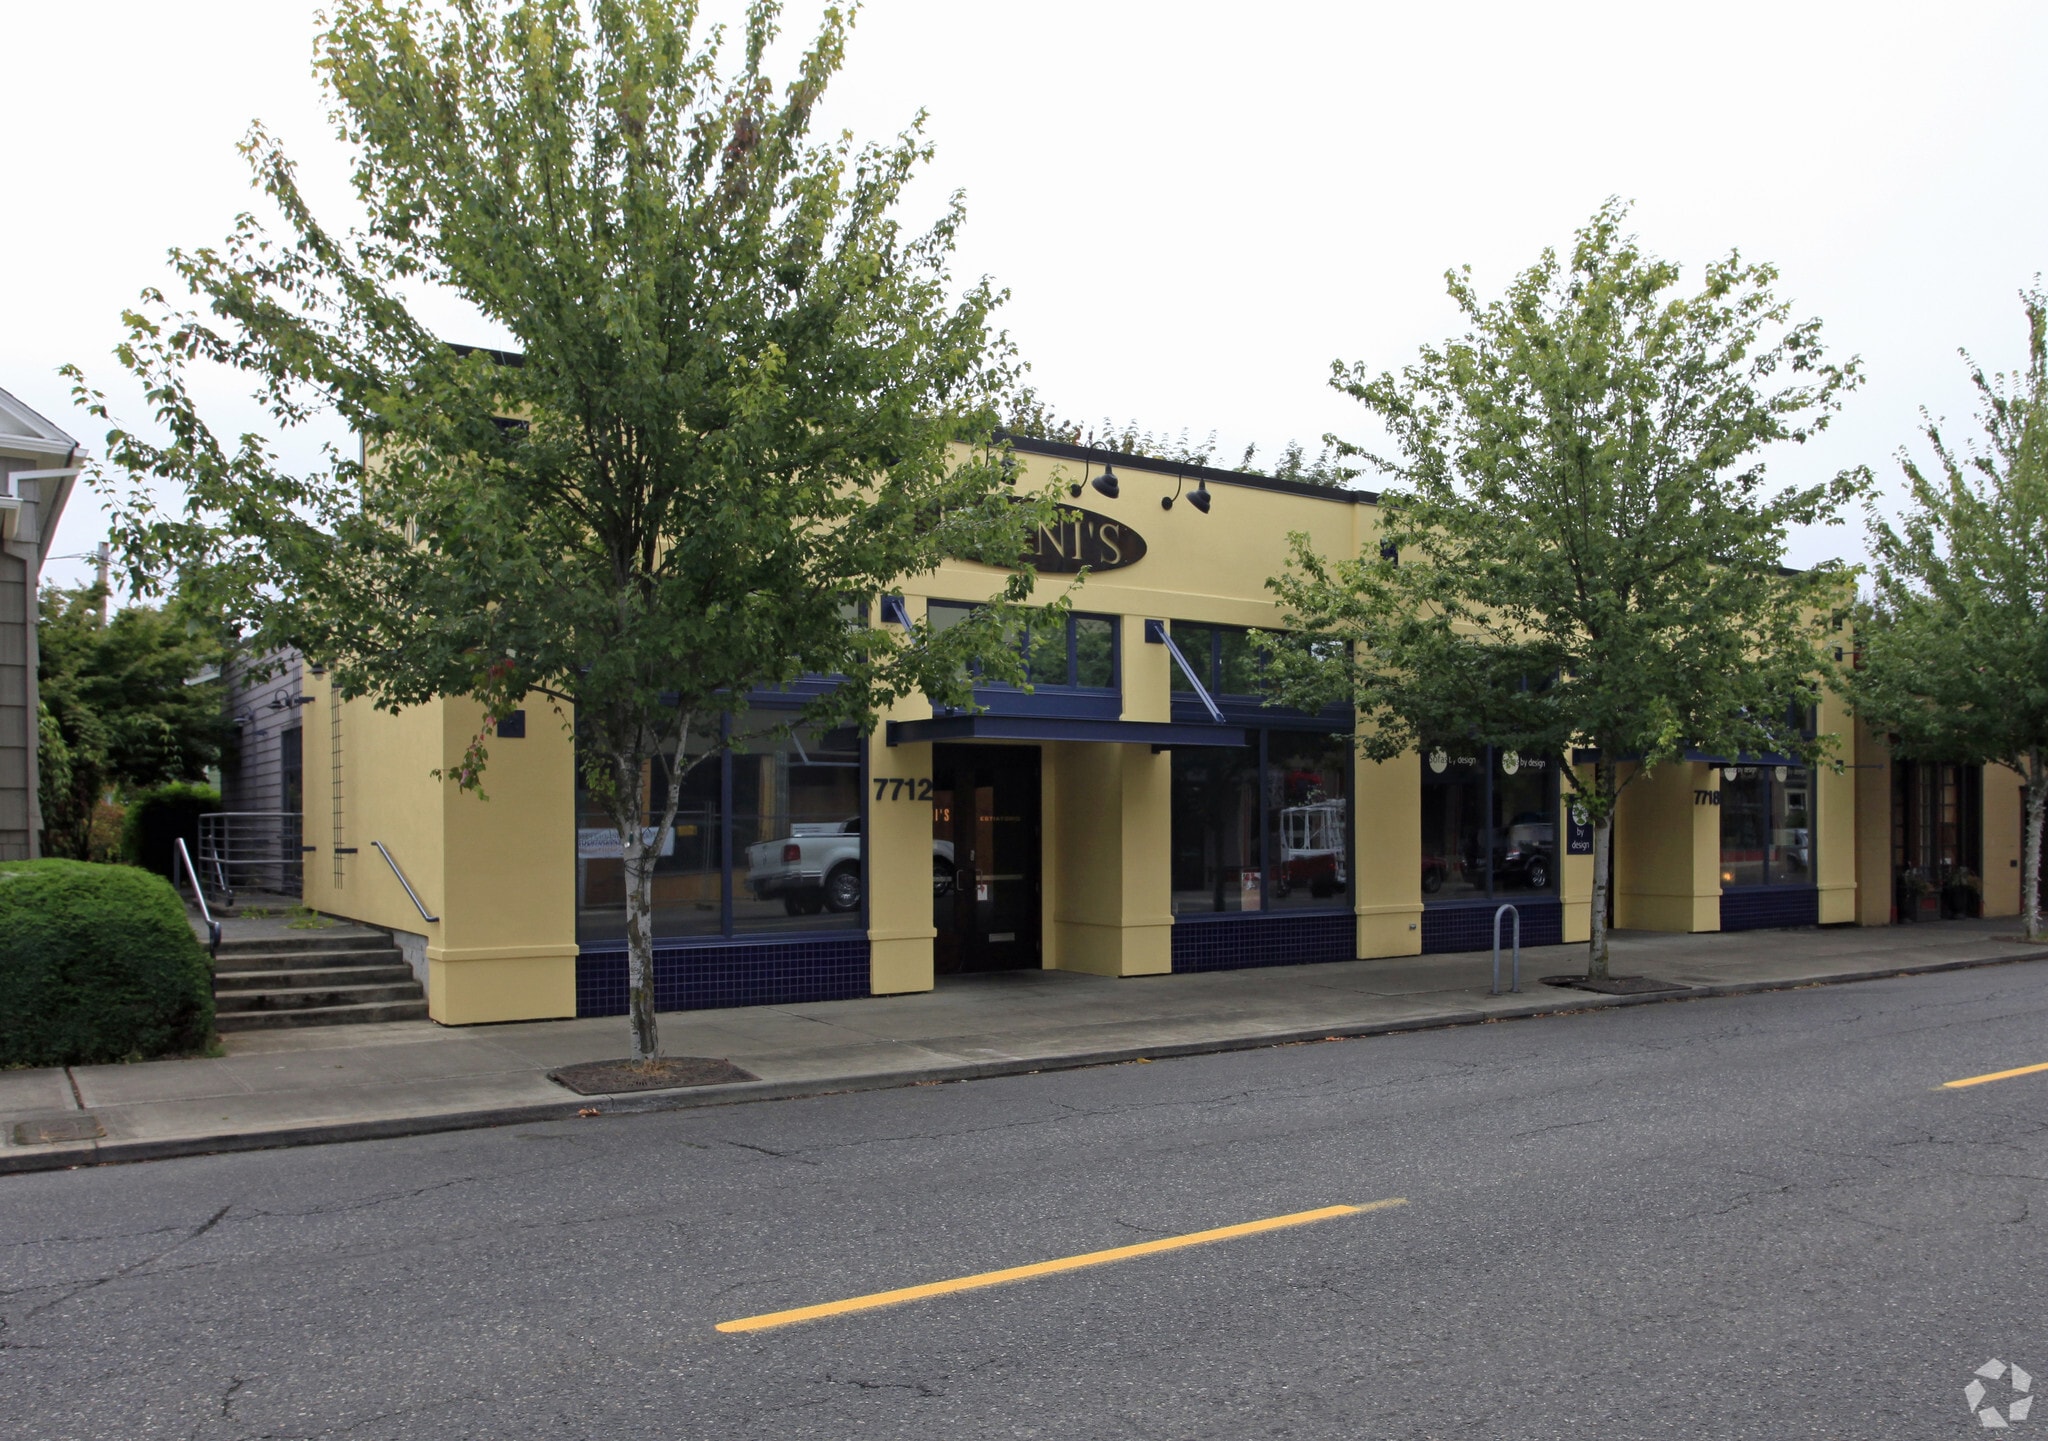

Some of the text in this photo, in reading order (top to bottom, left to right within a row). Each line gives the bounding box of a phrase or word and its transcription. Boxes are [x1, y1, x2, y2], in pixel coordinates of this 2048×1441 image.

[1457, 755, 1477, 766] design
[1520, 757, 1528, 767] by
[1528, 758, 1546, 769] design
[873, 778, 934, 801] 7712
[1694, 790, 1720, 806] 7718
[1576, 827, 1585, 837] by
[1571, 840, 1590, 851] design
